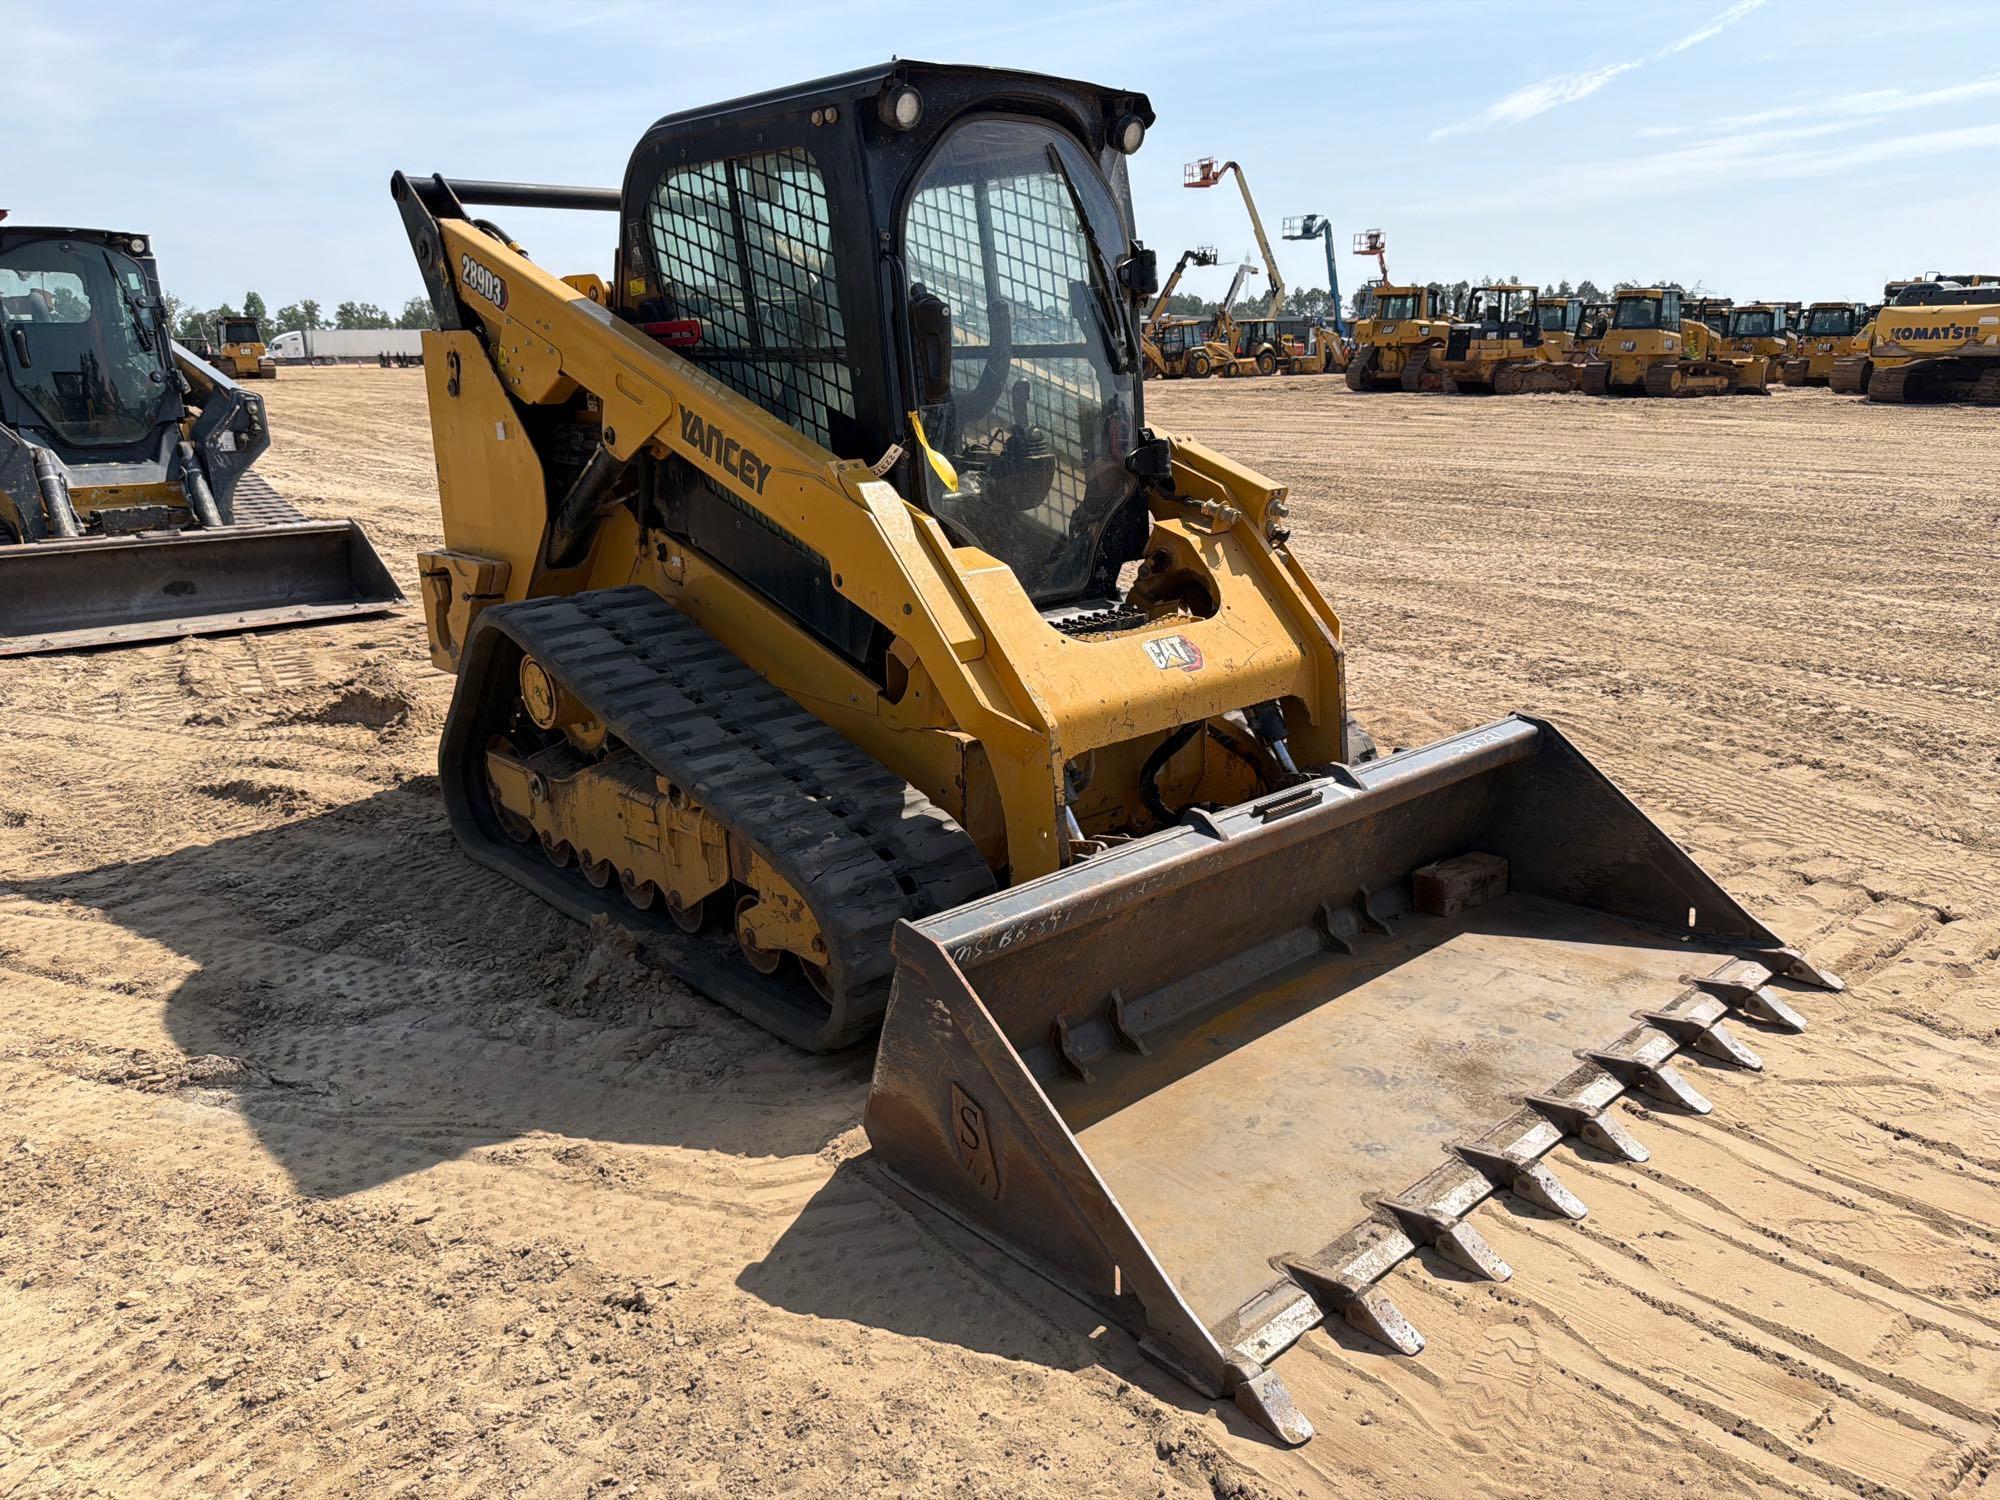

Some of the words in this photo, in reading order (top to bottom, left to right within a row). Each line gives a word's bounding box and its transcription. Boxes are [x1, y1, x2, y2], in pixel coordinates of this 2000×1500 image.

[462, 254, 501, 306] 289D3
[1891, 323, 1979, 340] KOMATSU
[1620, 341, 1634, 350] CAT
[1817, 343, 1831, 351] CAT
[679, 403, 772, 496] YANCEY
[1143, 635, 1191, 669] CAT
